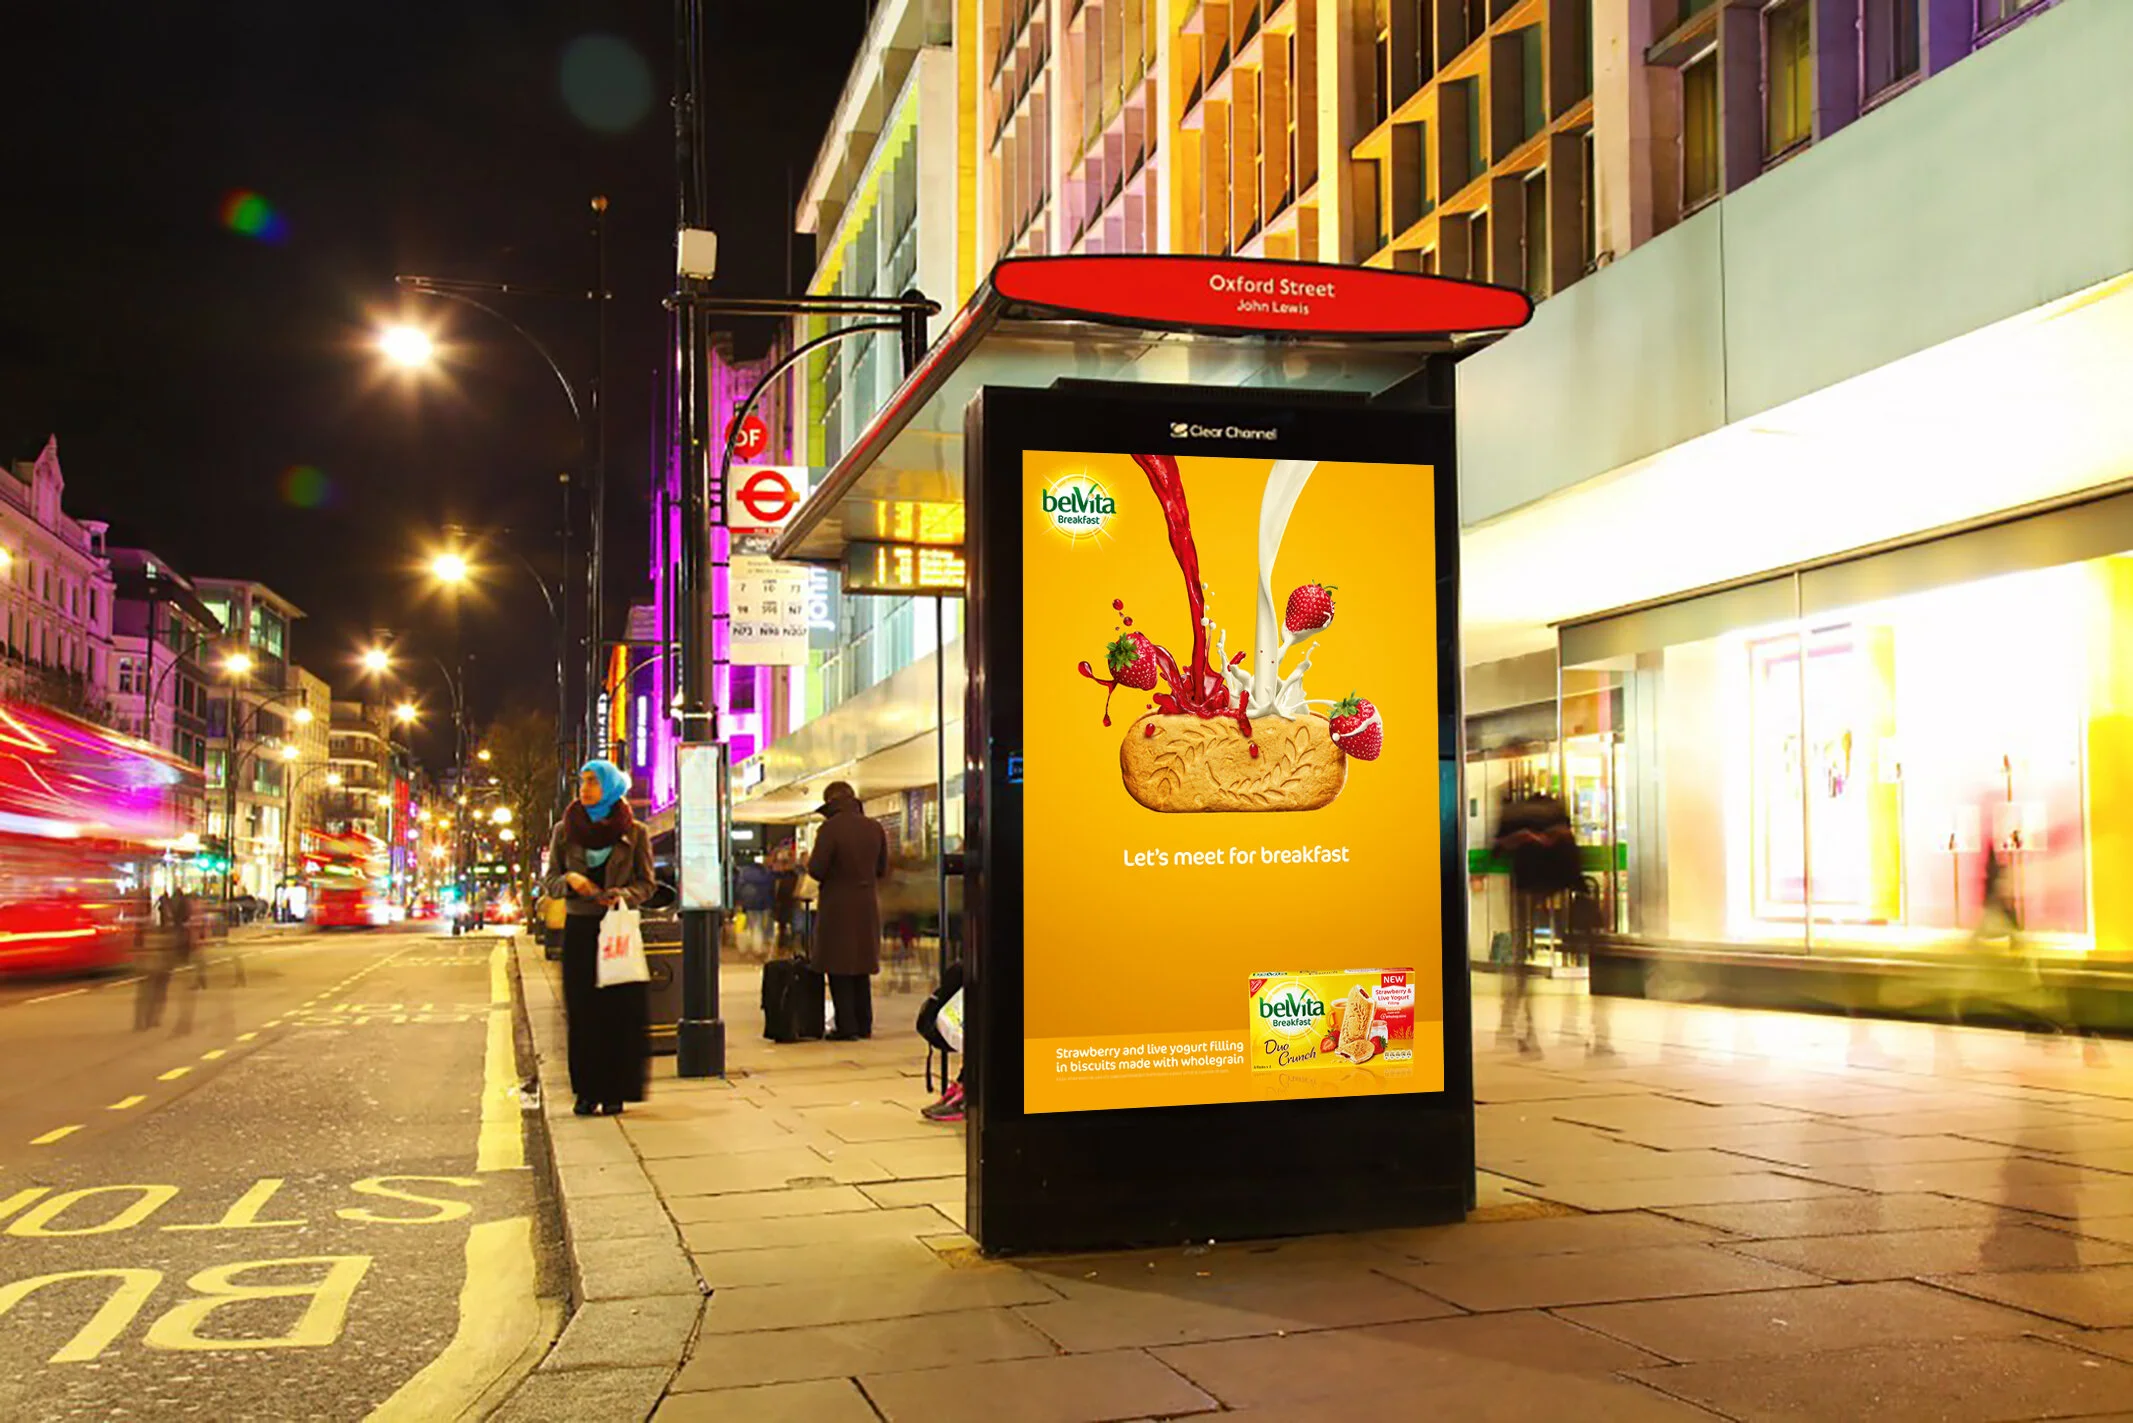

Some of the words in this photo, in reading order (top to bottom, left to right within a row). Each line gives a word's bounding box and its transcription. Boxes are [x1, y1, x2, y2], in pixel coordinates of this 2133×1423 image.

[1209, 274, 1274, 295] Oxford
[1279, 278, 1336, 298] Street
[1237, 299, 1270, 313] John
[1271, 301, 1310, 316] Lewis
[1189, 424, 1223, 438] Clear
[1225, 426, 1278, 440] Channel
[1042, 483, 1117, 514] belVita
[1057, 514, 1101, 525] Breakfast
[1123, 848, 1169, 867] Let’s
[1173, 848, 1225, 866] meet
[1229, 846, 1257, 865] for
[1261, 845, 1350, 864] breakfast
[1383, 975, 1404, 984] NEW
[1375, 988, 1407, 996] Strawberry
[1259, 989, 1325, 1018] belVita
[1272, 1018, 1312, 1027] Breakfast
[1056, 1046, 1121, 1060] Strawberry
[1122, 1044, 1146, 1057] and
[1147, 1043, 1168, 1055] live
[1169, 1042, 1208, 1057] yogurt
[1209, 1040, 1244, 1053] filling
[1264, 1039, 1290, 1054] Duo
[1278, 1046, 1317, 1067] Crunch
[1056, 1062, 1068, 1073] in
[1070, 1060, 1117, 1072] biscuits
[1118, 1058, 1151, 1070] made
[1153, 1056, 1179, 1068] with
[1181, 1053, 1244, 1067] wholegrain
[0, 1175, 484, 1238] STO
